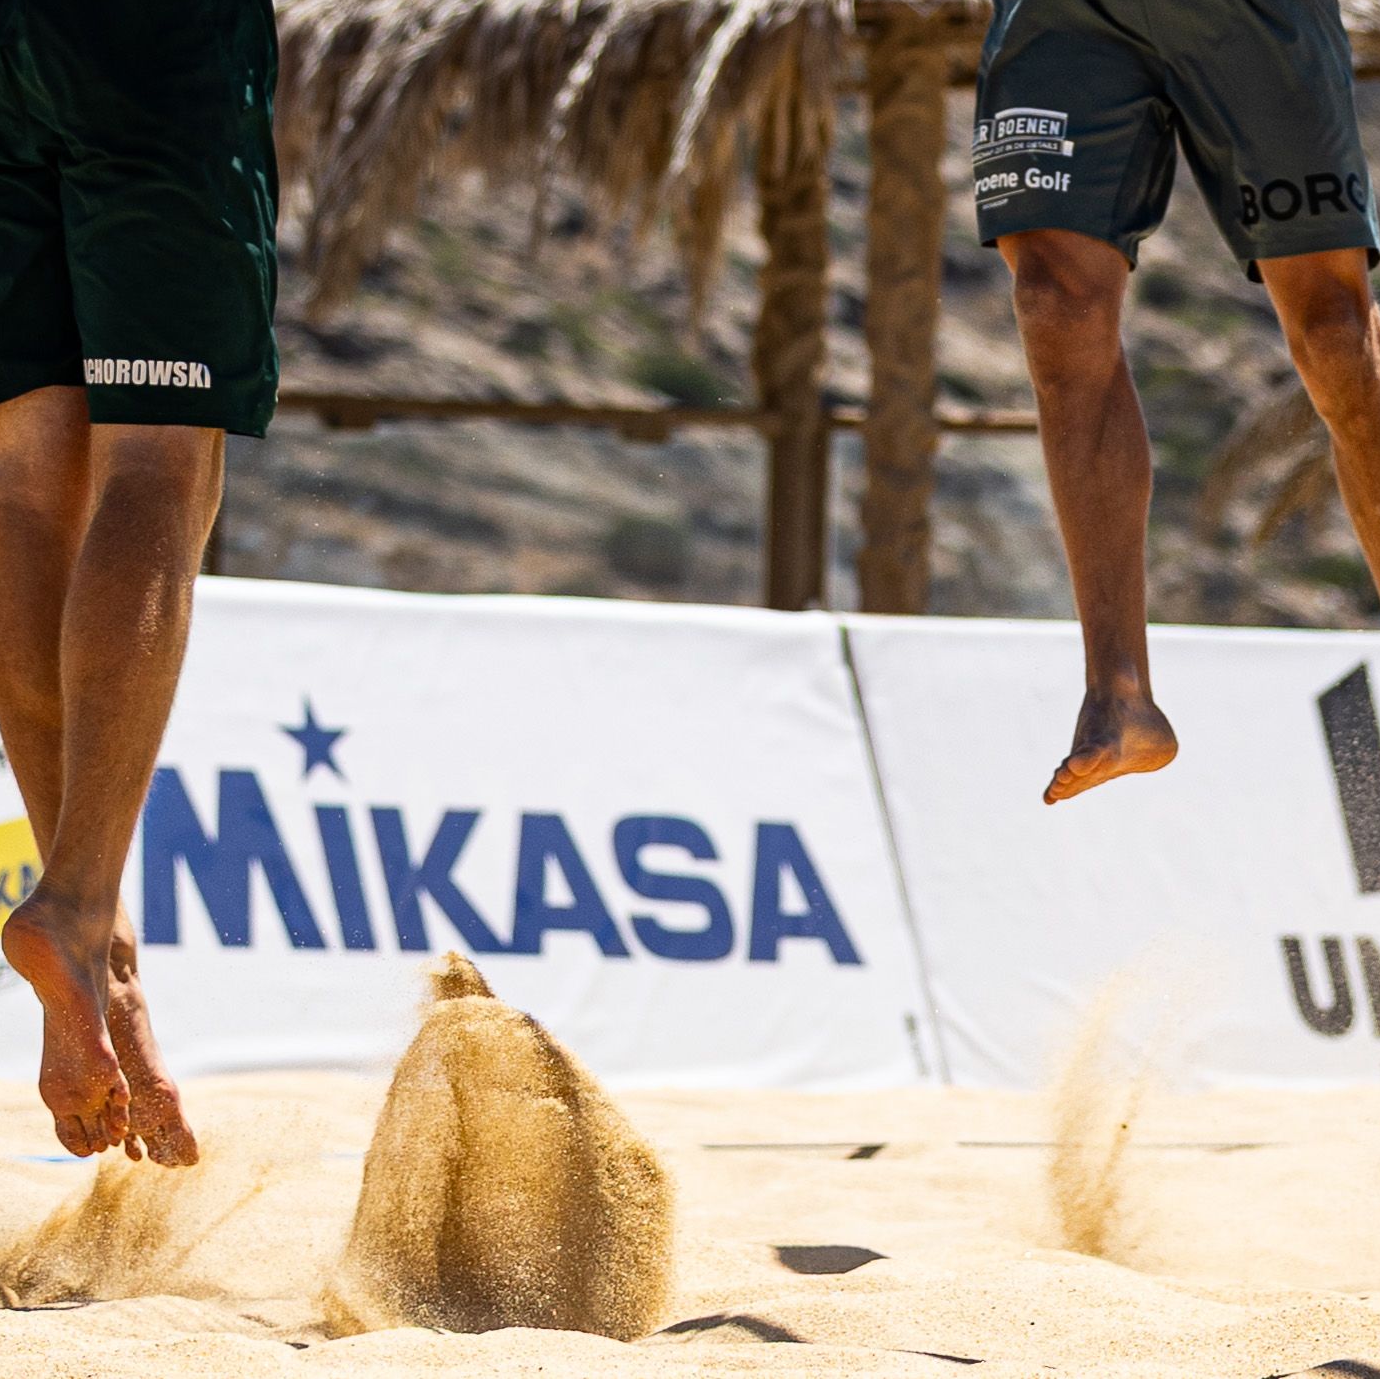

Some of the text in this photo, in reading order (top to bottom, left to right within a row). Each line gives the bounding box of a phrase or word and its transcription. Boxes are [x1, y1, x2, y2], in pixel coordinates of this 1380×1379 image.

[997, 117, 1061, 139] BOENEN
[1024, 167, 1071, 192] Golf
[141, 765, 865, 966] MIKASA
